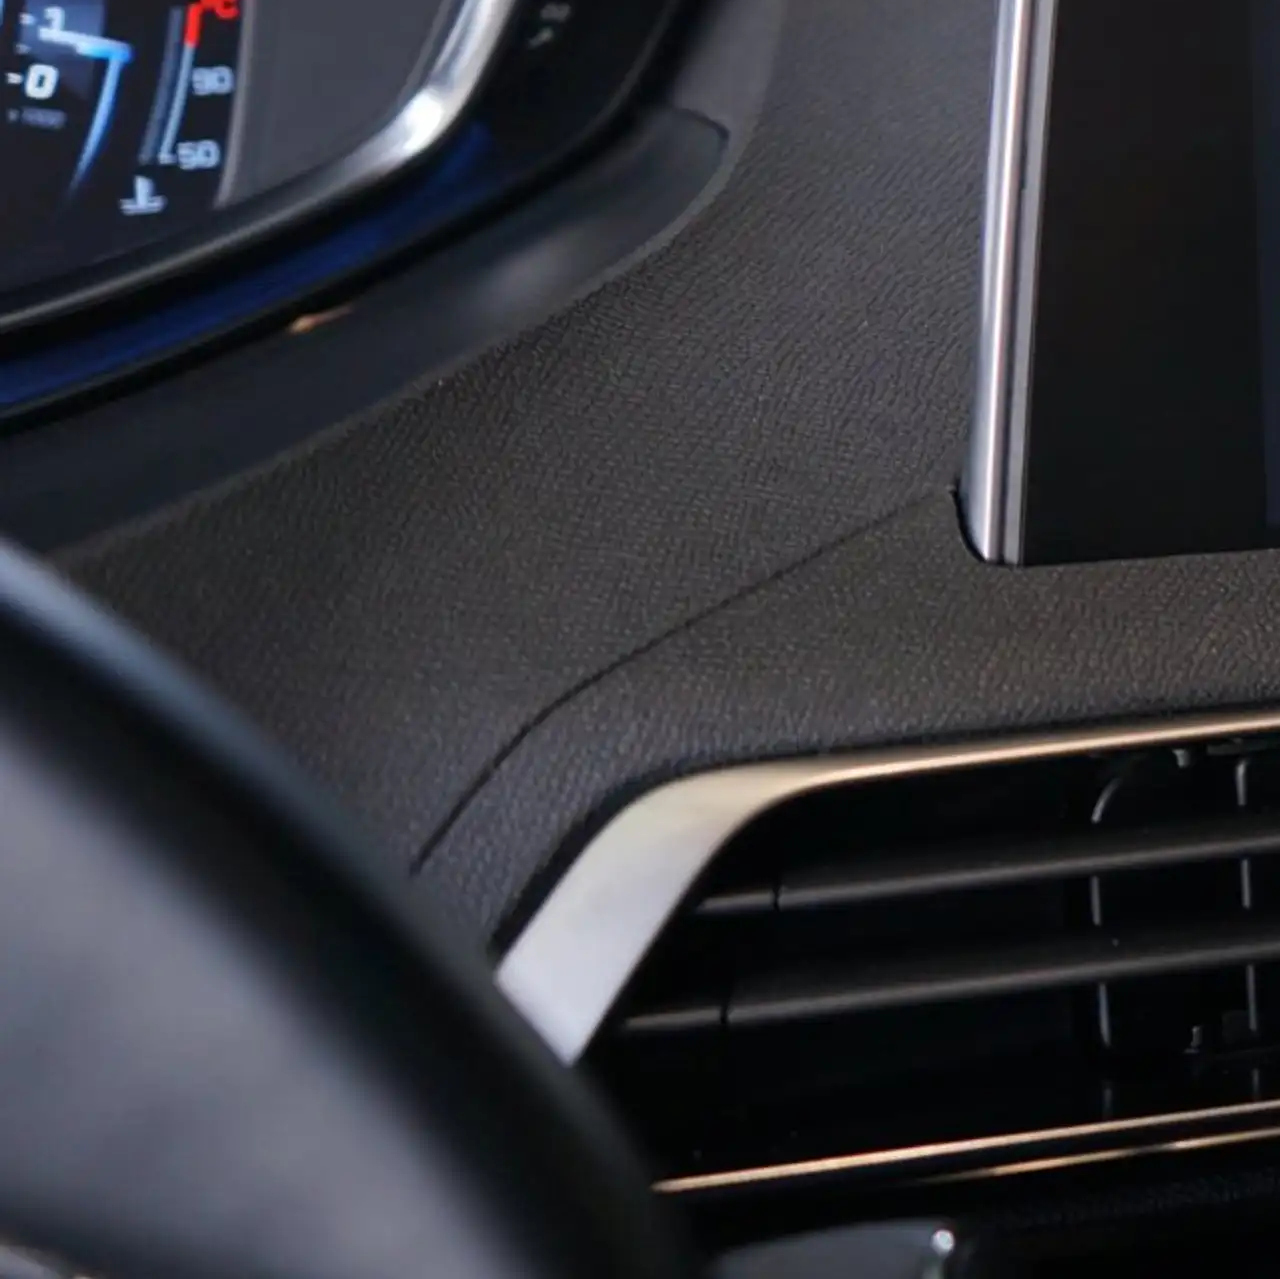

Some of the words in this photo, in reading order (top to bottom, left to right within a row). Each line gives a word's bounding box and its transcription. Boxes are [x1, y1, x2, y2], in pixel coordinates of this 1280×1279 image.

[24, 63, 59, 99] 0
[193, 65, 235, 97] 90
[177, 138, 221, 170] 50
